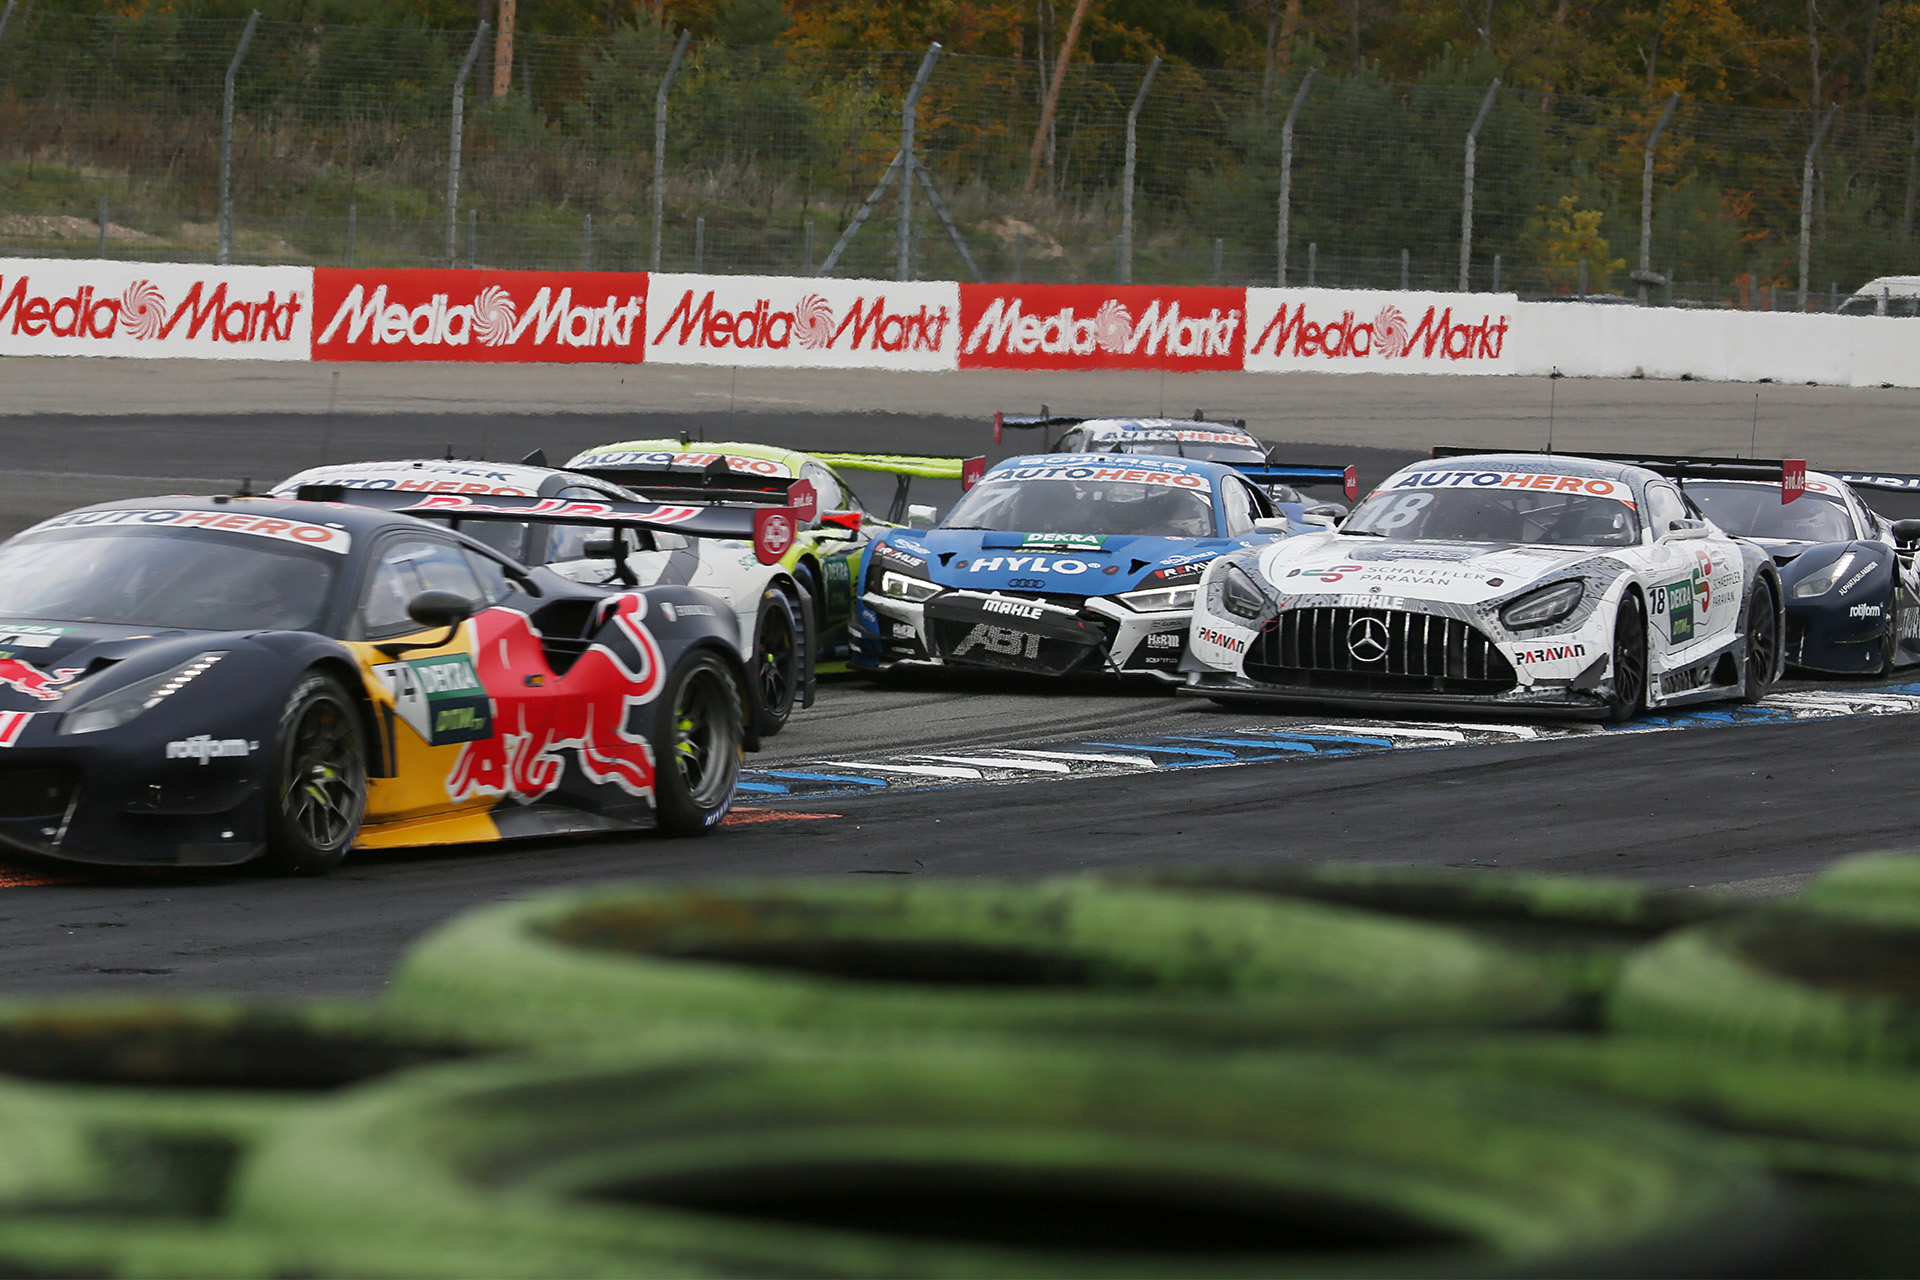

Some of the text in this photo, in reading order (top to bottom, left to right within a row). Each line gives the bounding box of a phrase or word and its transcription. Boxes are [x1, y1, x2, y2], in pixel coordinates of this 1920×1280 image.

[156, 281, 301, 343] Markt
[317, 283, 641, 347] Media Markt
[652, 289, 950, 352] Media Markt
[964, 297, 1238, 357] Media Markt
[1251, 302, 1508, 360] Media Markt
[988, 468, 1201, 487] AUTOHERO
[1393, 473, 1614, 495] AUTOHERO
[1357, 492, 1434, 531] 18
[46, 510, 332, 543] AUTOHERO
[1027, 533, 1099, 543] DEKRA
[970, 557, 1088, 575] HYLO
[1367, 565, 1486, 581] SCHAEFFLER
[1360, 574, 1450, 586] PARAVAN
[982, 599, 1043, 619] MAHLE
[1340, 594, 1404, 610] MAHLE
[1649, 588, 1665, 614] 18
[1850, 603, 1880, 620] rotiform
[952, 623, 1051, 659] ABT
[1198, 627, 1244, 653] PARAVAN
[1515, 644, 1585, 665] PARAVAN
